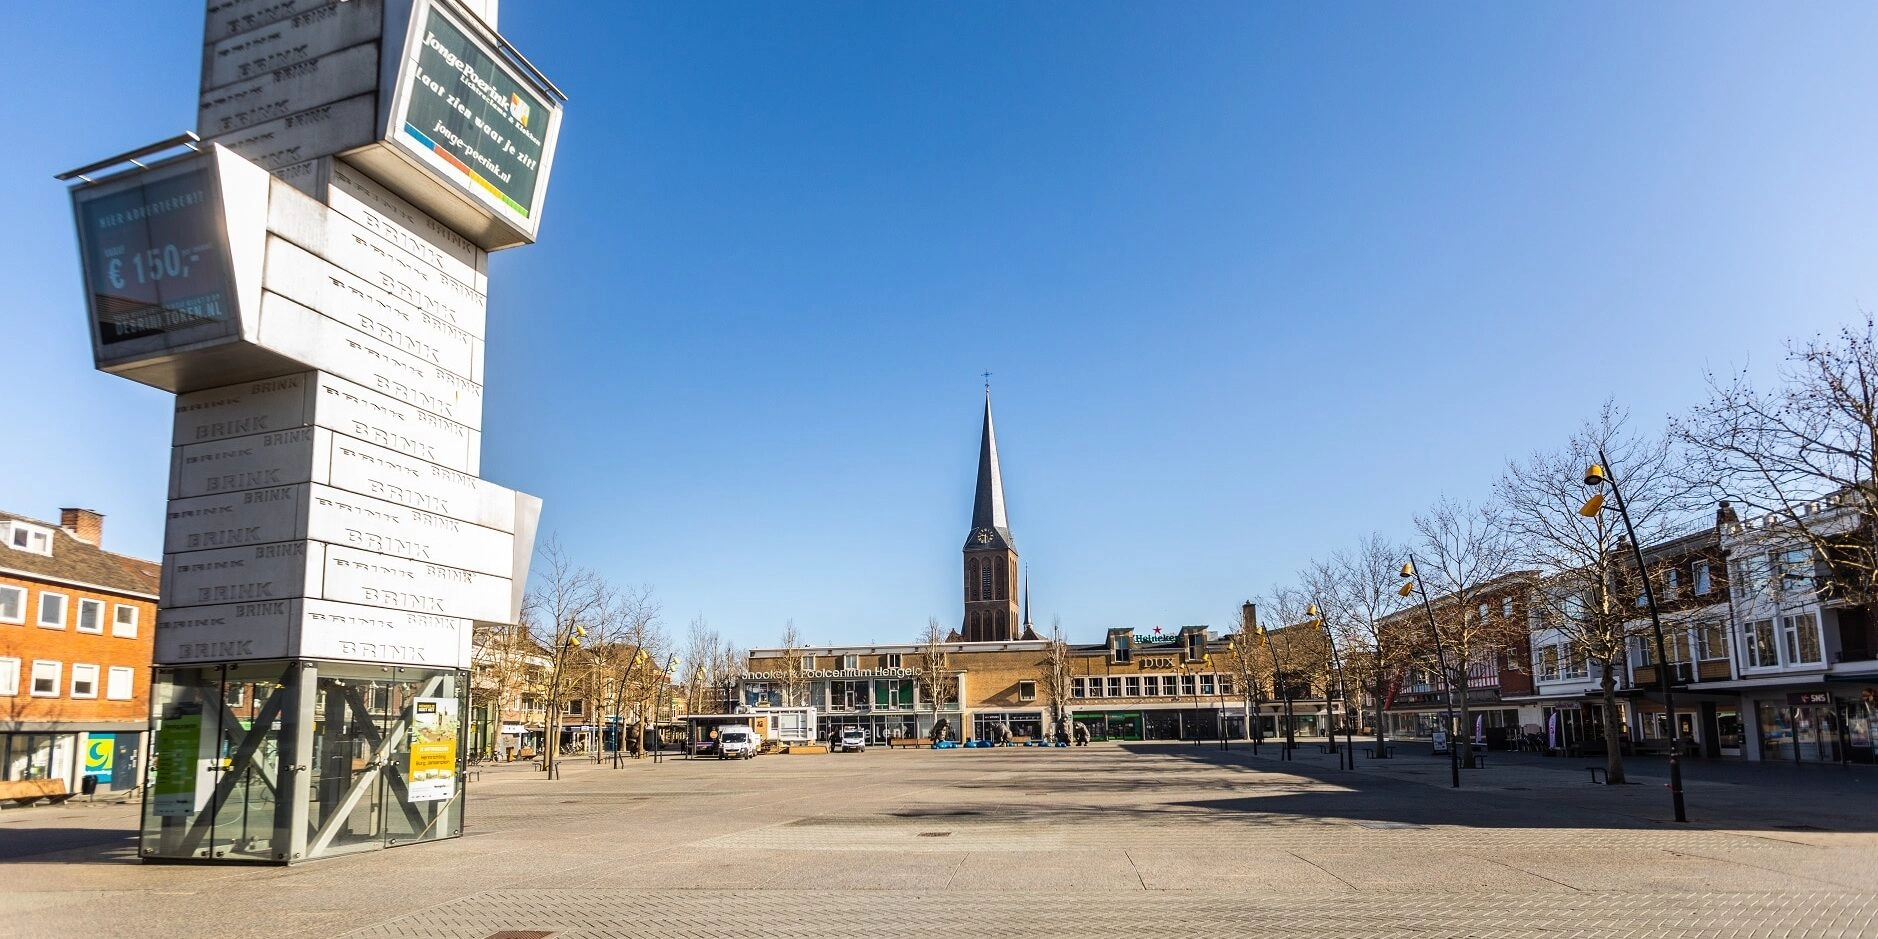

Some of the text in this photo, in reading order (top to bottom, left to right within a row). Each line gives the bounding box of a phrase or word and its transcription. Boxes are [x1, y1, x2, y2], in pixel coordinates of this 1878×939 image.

[415, 67, 537, 172] Laat zien waar je zit!
[432, 119, 512, 184] jonge-poerink.nl
[108, 258, 126, 290] €
[358, 313, 440, 364] BRINK
[420, 312, 469, 345] BRINK
[346, 338, 425, 378] BRINK
[251, 378, 299, 396] BRINK
[434, 368, 481, 398] BRINK
[176, 396, 241, 414] BRINK
[322, 385, 405, 422] BRINK
[374, 373, 453, 418] BRINK
[196, 414, 269, 441] BRINK
[416, 410, 465, 438] BRINK
[263, 428, 313, 448] BRINK
[352, 419, 436, 461] BRINK
[186, 447, 255, 465] BRINK
[339, 446, 421, 478] BRINK
[206, 467, 282, 492] BRINK
[430, 465, 477, 490] BRINK
[243, 486, 293, 505] BRINK
[368, 478, 449, 514] BRINK
[168, 504, 234, 520] BRINK
[315, 496, 400, 524] BRINK
[411, 510, 461, 533] BRINK
[186, 526, 262, 548] BRINK
[345, 528, 431, 560] BRINK
[255, 542, 305, 560] BRINK
[177, 558, 245, 574] BRINK
[333, 557, 415, 579] BRINK
[425, 564, 474, 585] BRINK
[198, 581, 273, 602] BRINK
[361, 586, 445, 613] BRINK
[235, 601, 285, 618] BRINK
[308, 612, 395, 629] BRINK
[159, 616, 227, 630] BRINK
[406, 613, 456, 631] BRINK
[177, 639, 254, 659] BRINK
[339, 640, 426, 662] BRINK
[875, 666, 923, 679] Hengelo
[1143, 658, 1176, 668] DUX
[1810, 693, 1826, 702] SNS
